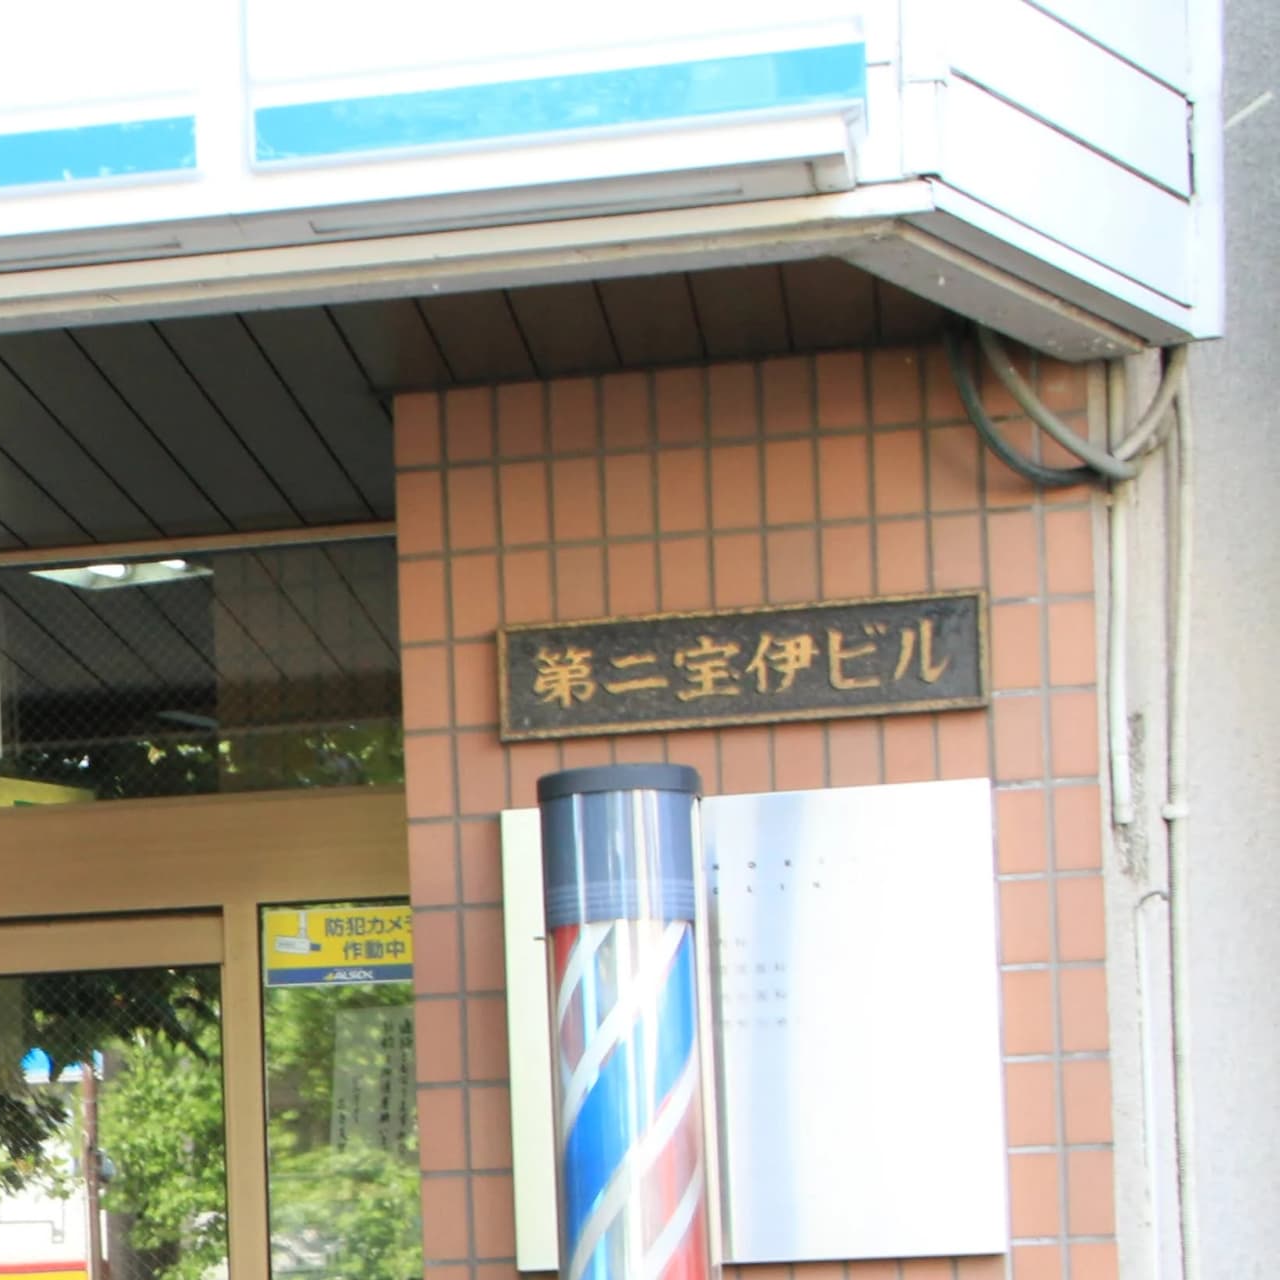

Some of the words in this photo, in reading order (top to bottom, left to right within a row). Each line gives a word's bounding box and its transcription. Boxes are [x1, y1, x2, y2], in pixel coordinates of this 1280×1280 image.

[532, 618, 948, 709] 第二宝伊ビル
[343, 939, 406, 960] 作動中
